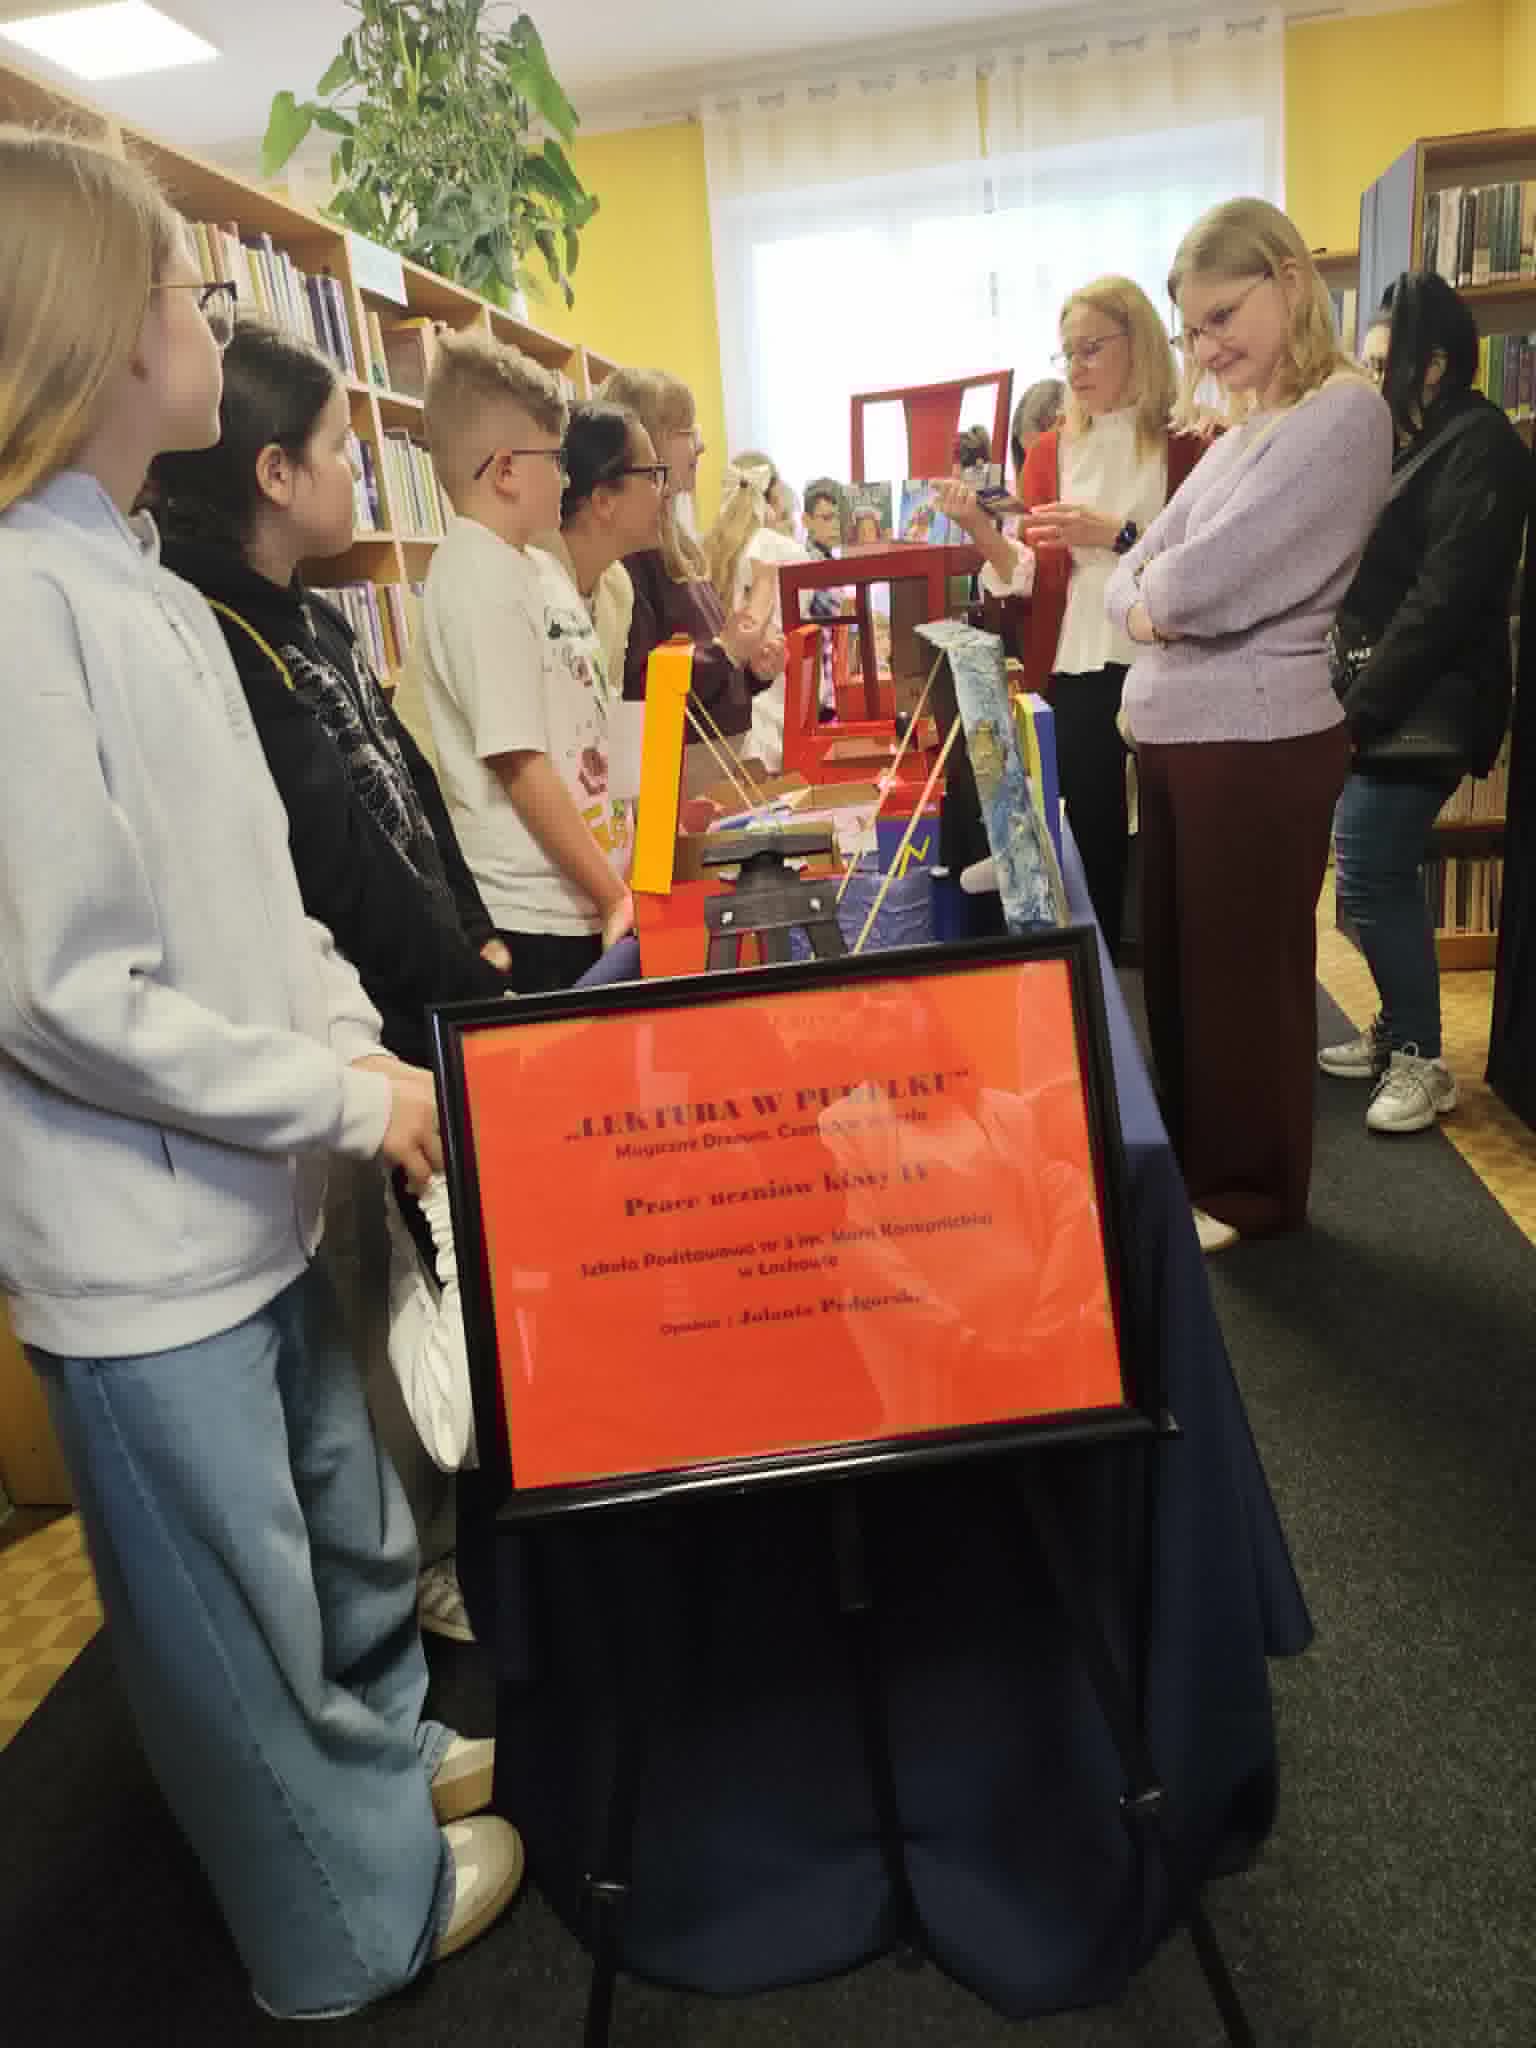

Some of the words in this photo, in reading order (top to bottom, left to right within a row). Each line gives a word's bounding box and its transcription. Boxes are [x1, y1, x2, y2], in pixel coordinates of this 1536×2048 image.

[751, 1092, 785, 1117] W
[624, 1193, 701, 1217] Prace
[737, 1266, 753, 1280] w
